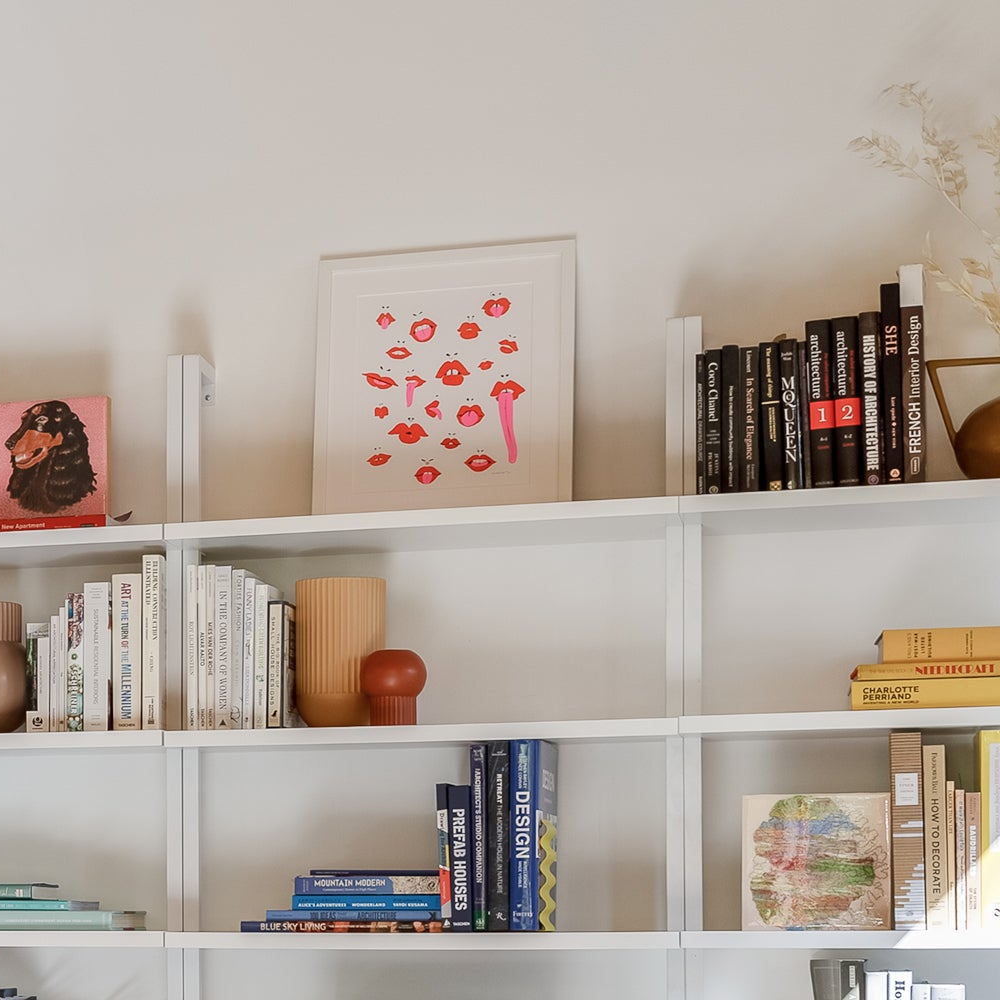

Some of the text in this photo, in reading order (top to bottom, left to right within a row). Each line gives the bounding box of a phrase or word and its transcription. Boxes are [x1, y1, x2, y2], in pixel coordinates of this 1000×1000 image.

[884, 325, 898, 356] SHE
[809, 334, 822, 399] architecture
[835, 331, 848, 396] architecture
[907, 315, 922, 453] FRENCH Interior Design
[708, 362, 719, 422] Coco Chanel
[841, 404, 853, 421] 2
[862, 335, 880, 471] HISTORY OF ARCHITECTURE
[744, 377, 755, 461] In Search of Elegance
[817, 408, 826, 422] 1
[120, 583, 131, 600] ART
[120, 600, 128, 609] AT
[120, 609, 128, 621] THE
[121, 640, 128, 649] OF
[219, 590, 227, 710] IN THE COMPANY OF WOMEN
[121, 664, 131, 720] MILLENNIUM
[863, 685, 920, 695] CHARLOTTE
[863, 693, 912, 701] PERRIAND
[515, 791, 530, 859] DESIGN
[931, 799, 941, 894] HOW TO DECORATE
[452, 809, 467, 911] PREFAB HOUSES
[314, 879, 385, 887] MOUNTAIN MODERN
[260, 922, 326, 931] BLUE SKY LIVING
